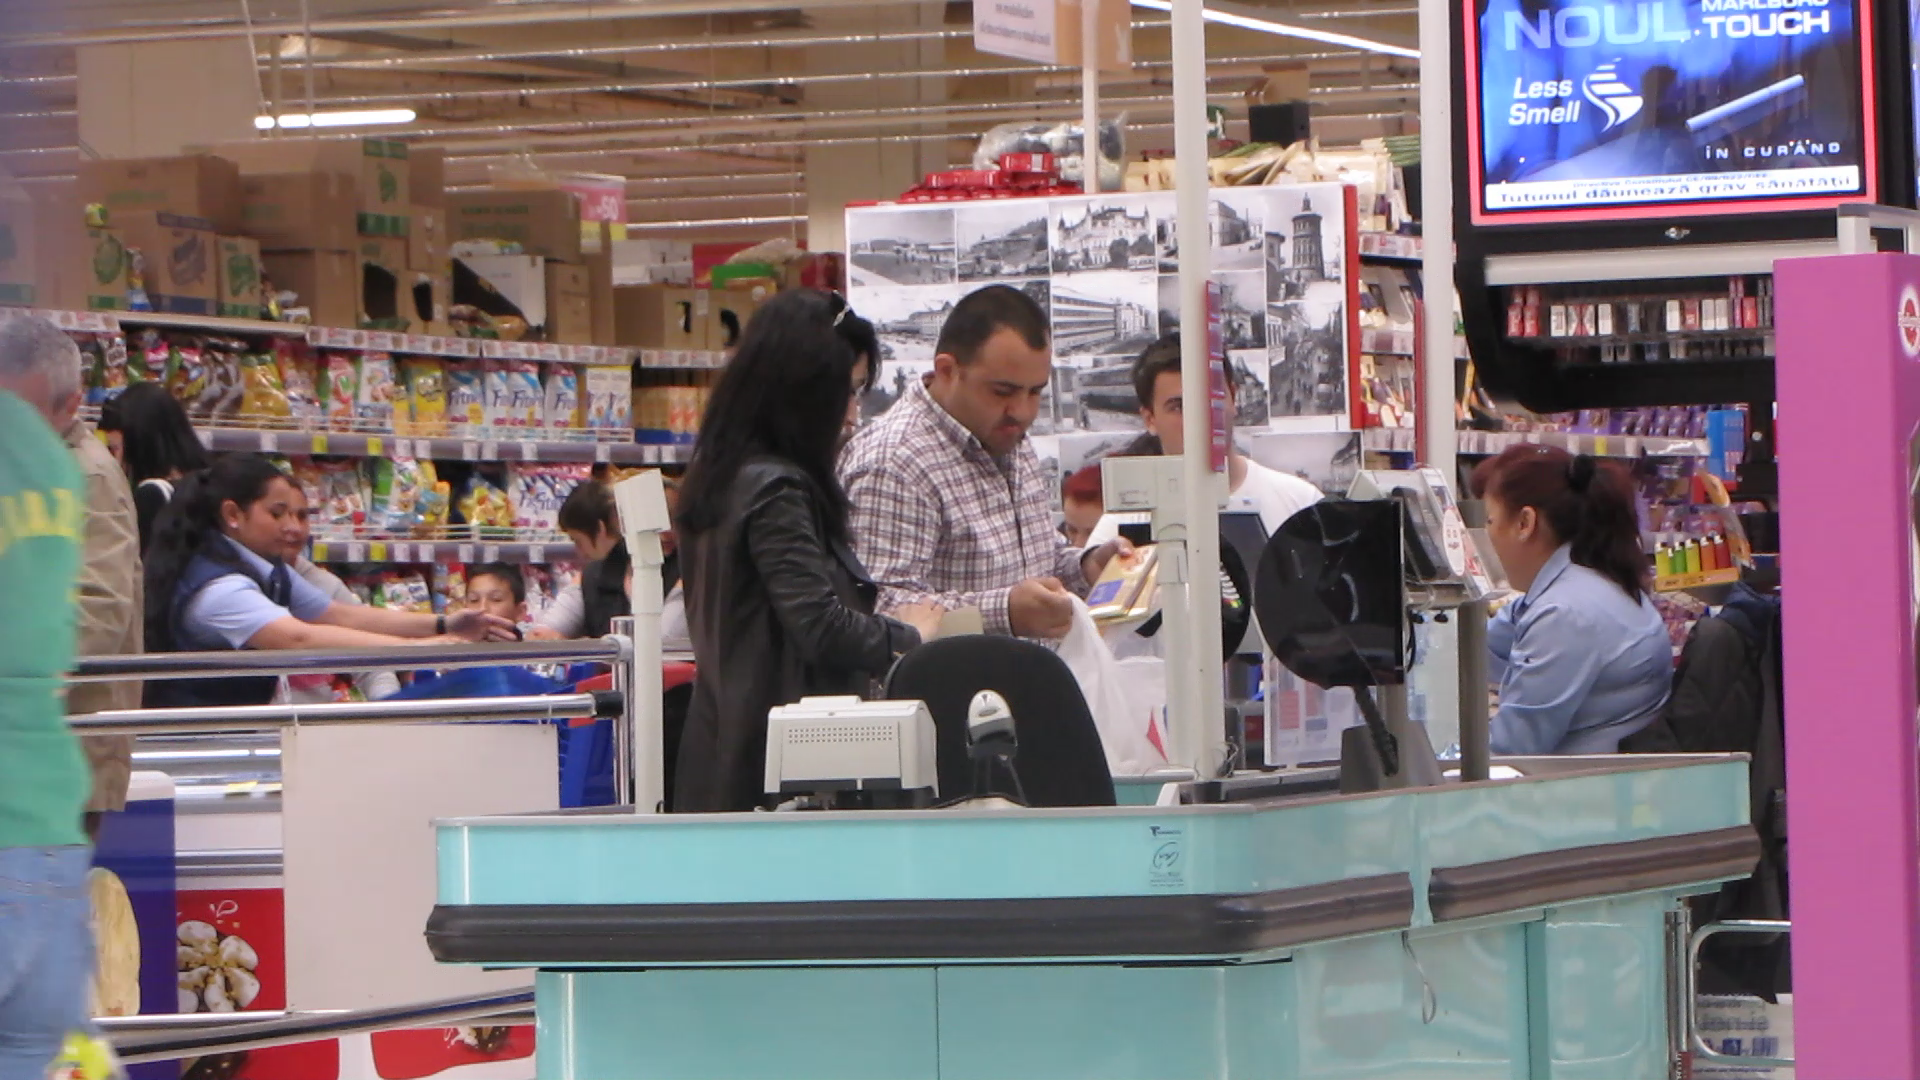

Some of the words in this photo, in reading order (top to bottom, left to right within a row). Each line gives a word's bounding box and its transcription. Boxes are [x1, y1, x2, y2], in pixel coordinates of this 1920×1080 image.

[1503, 2, 1692, 50] NOUL
[1702, 10, 1830, 39] TOUCH
[1513, 77, 1573, 99] Less
[1508, 100, 1581, 125] Smell
[1501, 190, 1577, 203] Tutunul
[1699, 183, 1746, 194] grav
